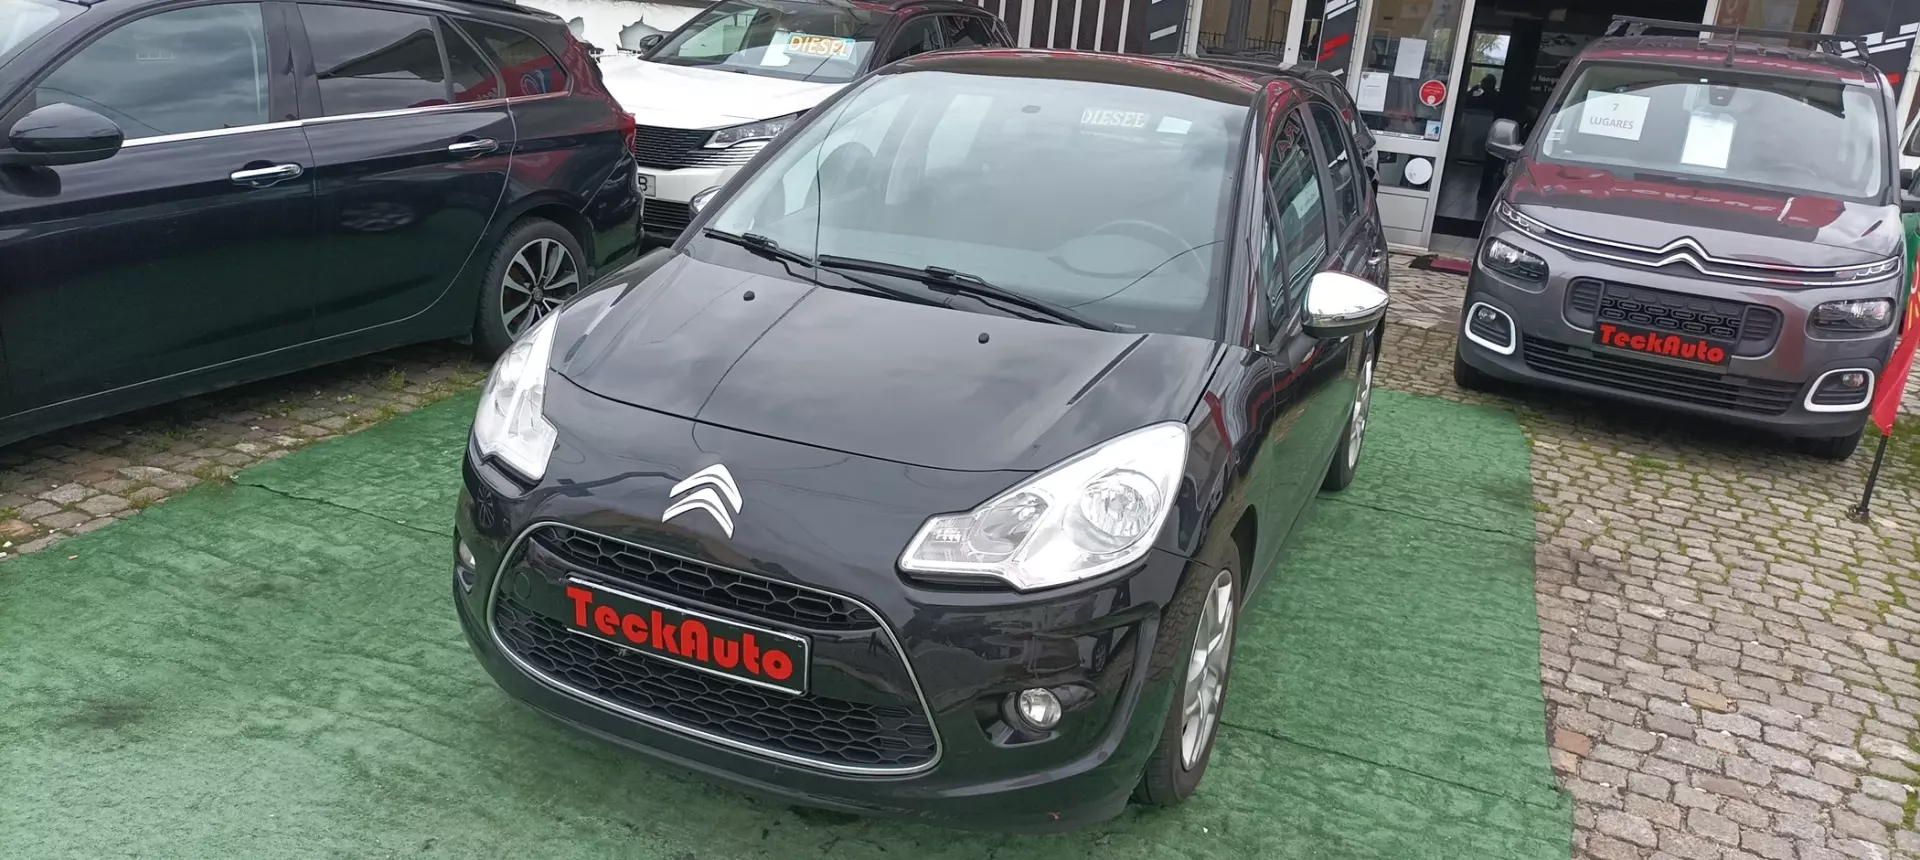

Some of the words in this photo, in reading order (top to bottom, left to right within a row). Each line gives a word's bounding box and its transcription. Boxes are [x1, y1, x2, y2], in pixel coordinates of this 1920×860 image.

[788, 35, 847, 57] DIESEL
[1080, 107, 1145, 128] DIESEL
[1612, 102, 1620, 112] 7
[1589, 115, 1634, 130] LUGARES
[1600, 323, 1725, 362] TeckAuto
[566, 586, 793, 680] TeckAuto
